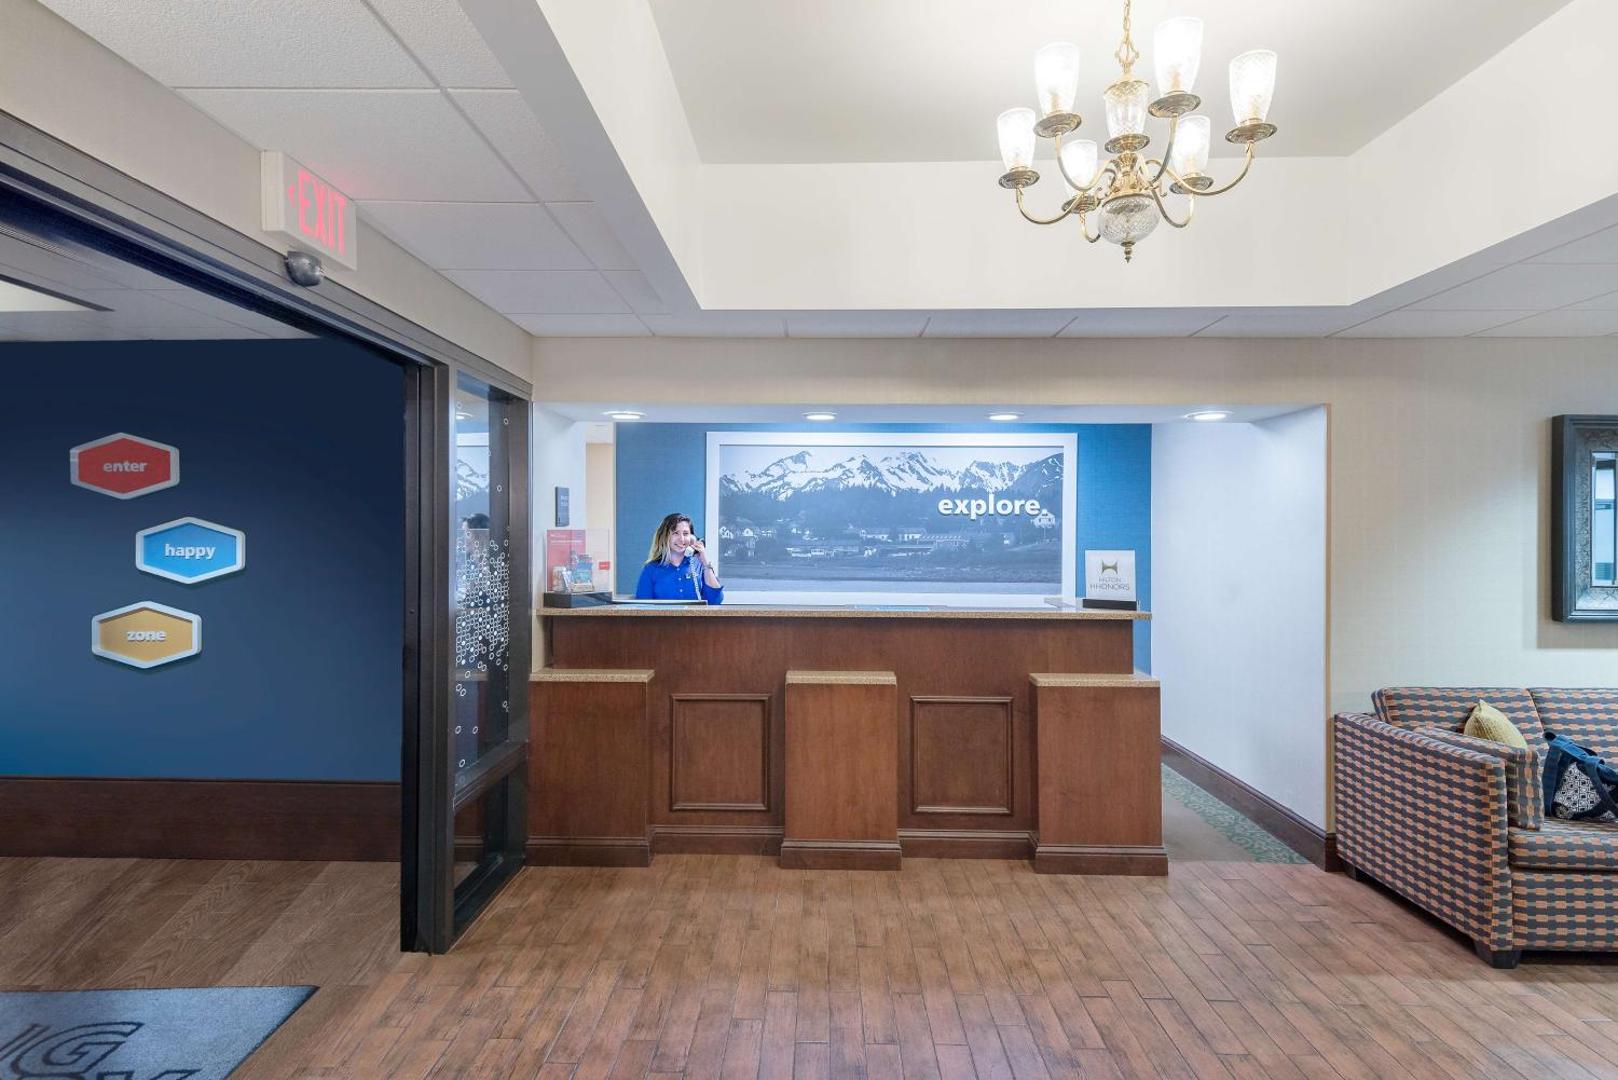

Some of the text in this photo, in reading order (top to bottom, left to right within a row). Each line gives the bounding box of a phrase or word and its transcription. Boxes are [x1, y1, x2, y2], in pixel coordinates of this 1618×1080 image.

[298, 168, 347, 256] EXIT
[103, 460, 148, 472] enter
[938, 494, 1047, 519] explore.
[164, 544, 216, 560] happy
[127, 630, 166, 641] zone
